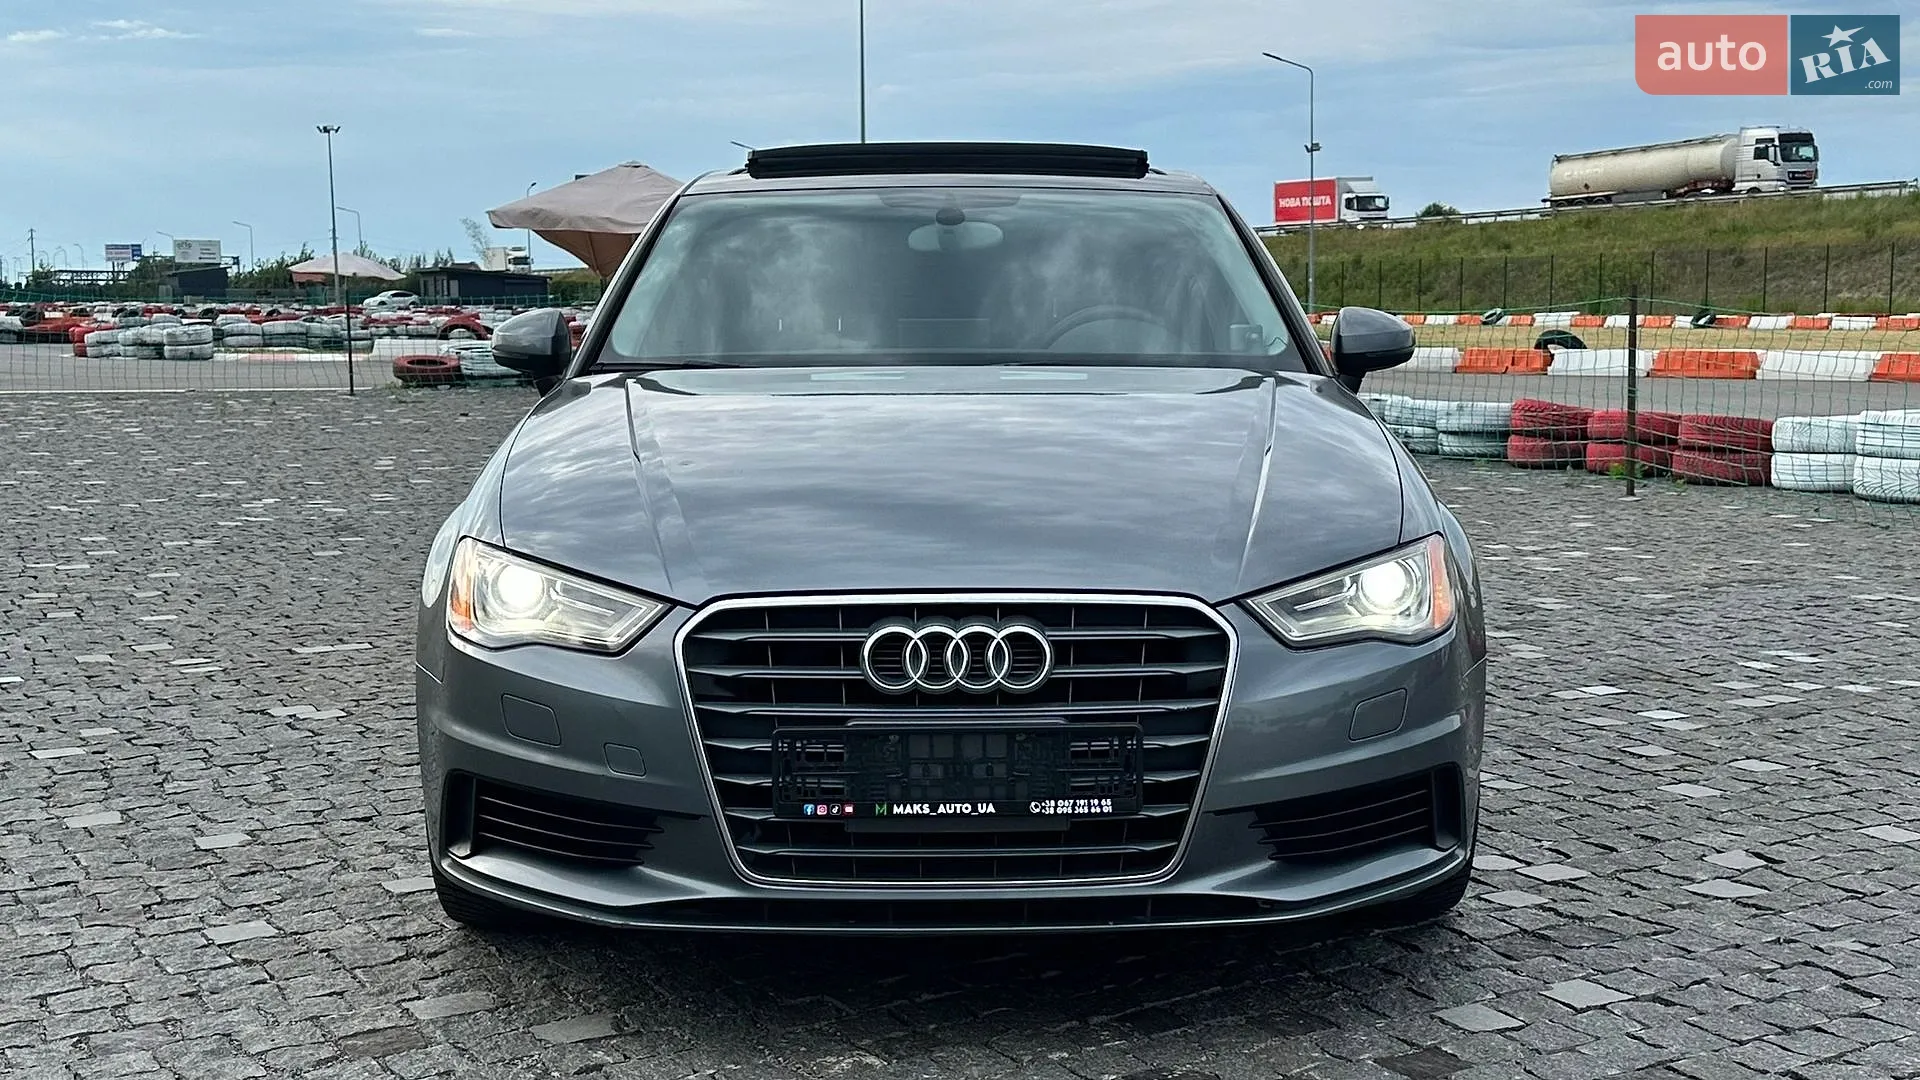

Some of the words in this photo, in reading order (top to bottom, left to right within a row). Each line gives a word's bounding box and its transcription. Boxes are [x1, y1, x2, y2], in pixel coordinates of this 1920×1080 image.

[1279, 197, 1301, 208] НОВА
[1075, 799, 1088, 807] 191
[893, 803, 996, 815] MAKS_AUTO_UA
[1056, 806, 1073, 814] 095
[1074, 806, 1089, 814] 365
